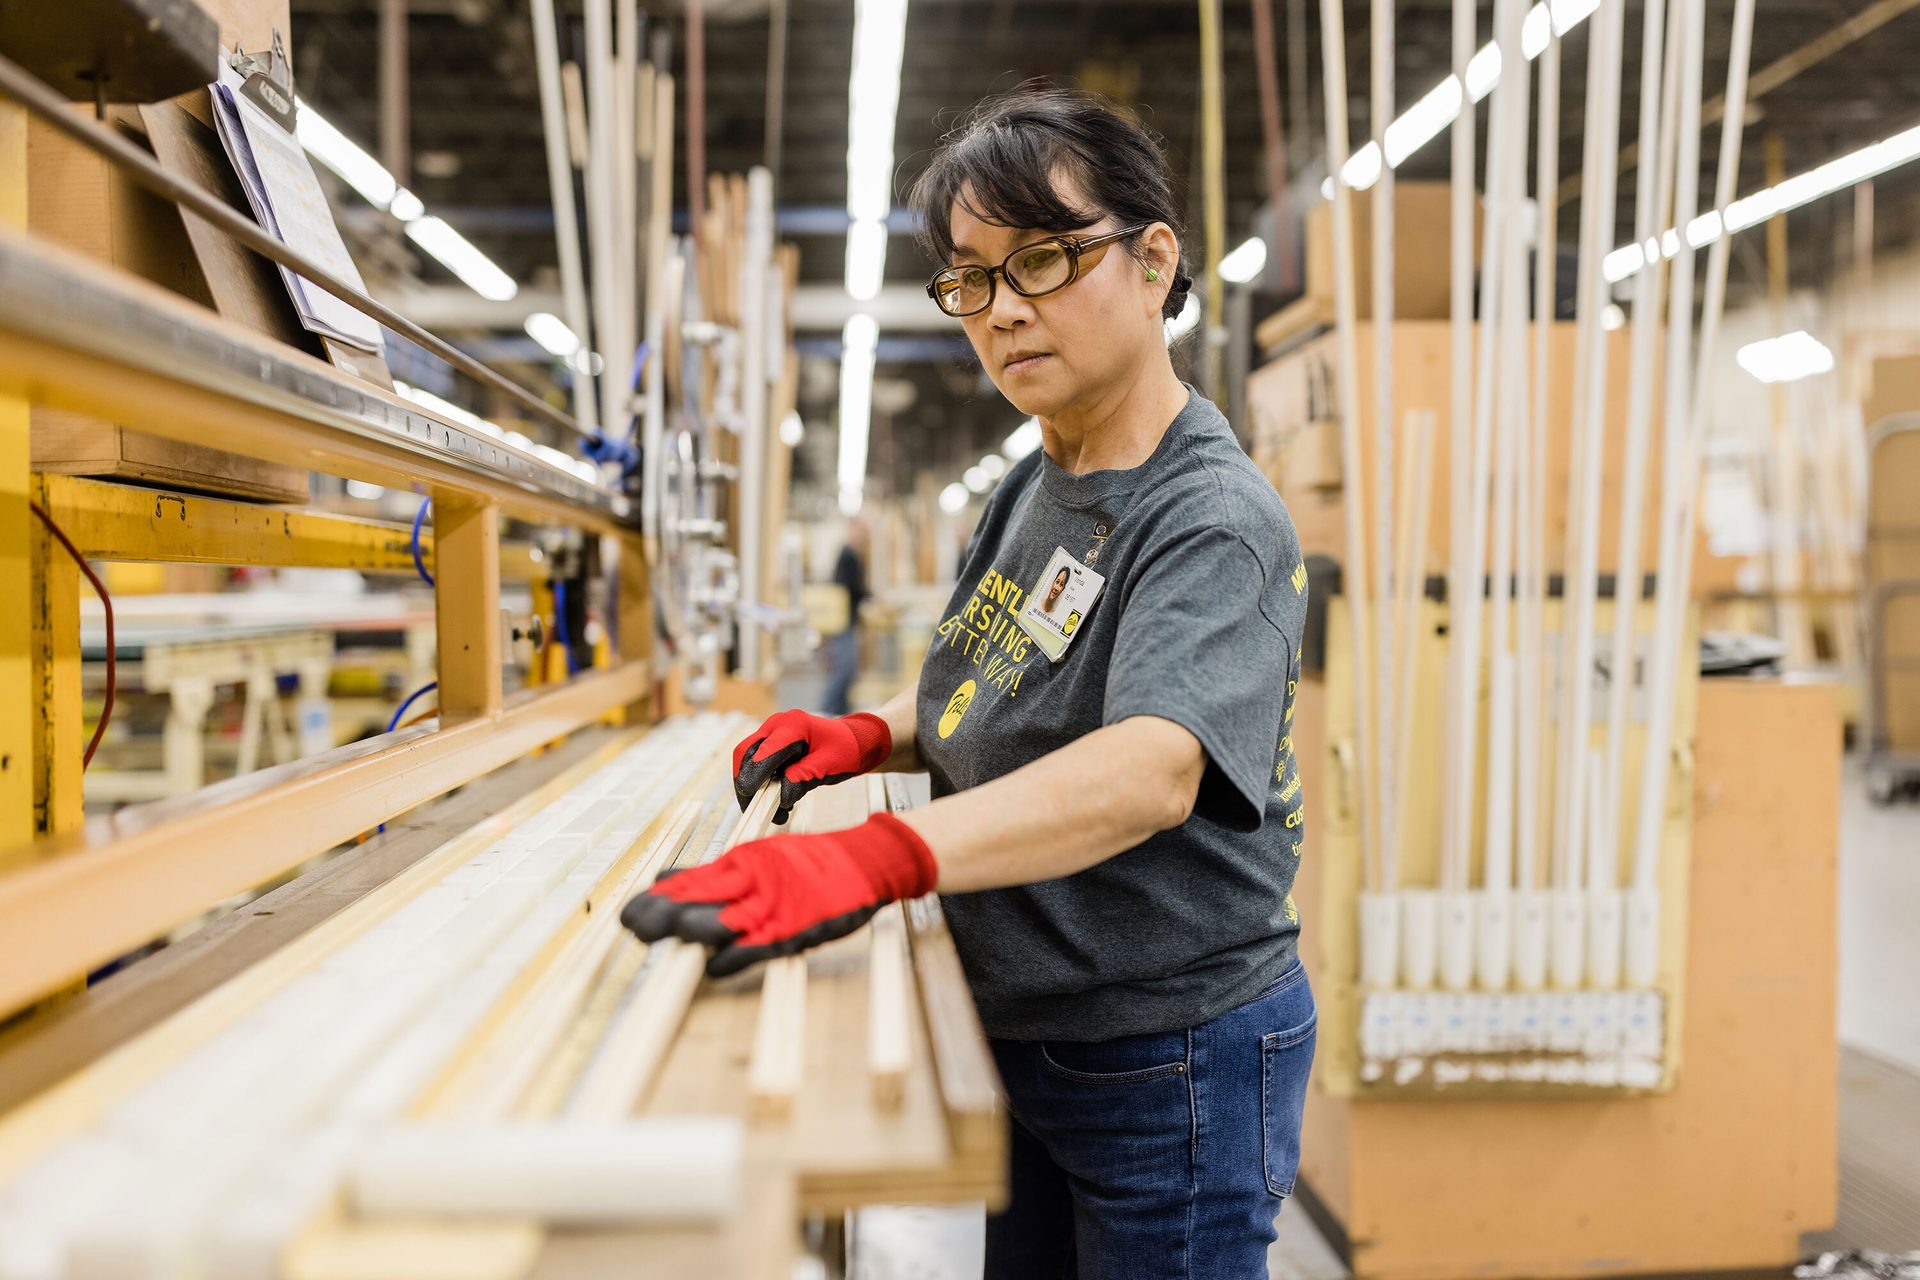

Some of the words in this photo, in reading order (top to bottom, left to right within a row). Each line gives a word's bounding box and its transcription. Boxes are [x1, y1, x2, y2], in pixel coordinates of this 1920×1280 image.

[977, 568, 1029, 618] ENTL
[983, 653, 1024, 697] WAY!
[1275, 771, 1301, 803] knowled
